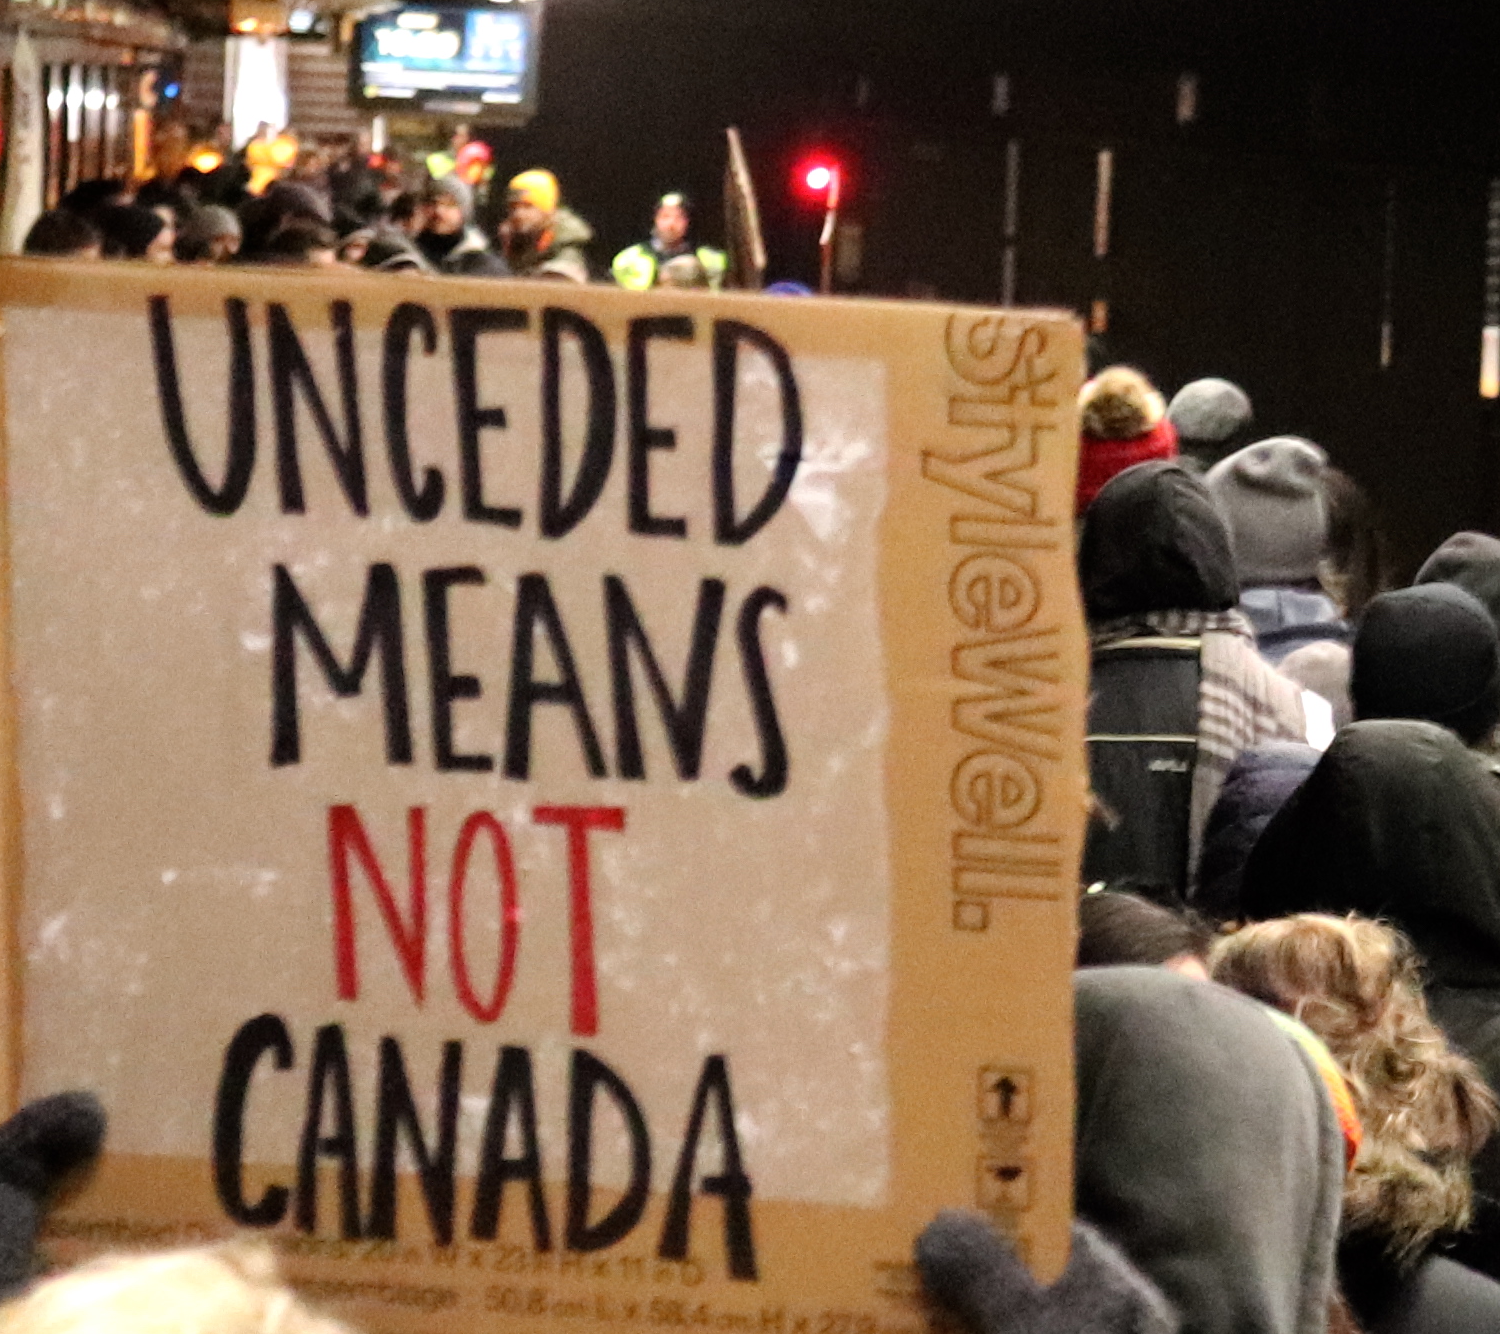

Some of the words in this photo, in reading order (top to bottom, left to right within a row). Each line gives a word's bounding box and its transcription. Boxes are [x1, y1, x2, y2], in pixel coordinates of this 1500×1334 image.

[151, 297, 803, 545] UNCEDED
[270, 564, 789, 798] MEANS
[328, 805, 625, 1036] NOT
[212, 1014, 758, 1281] CANADA
